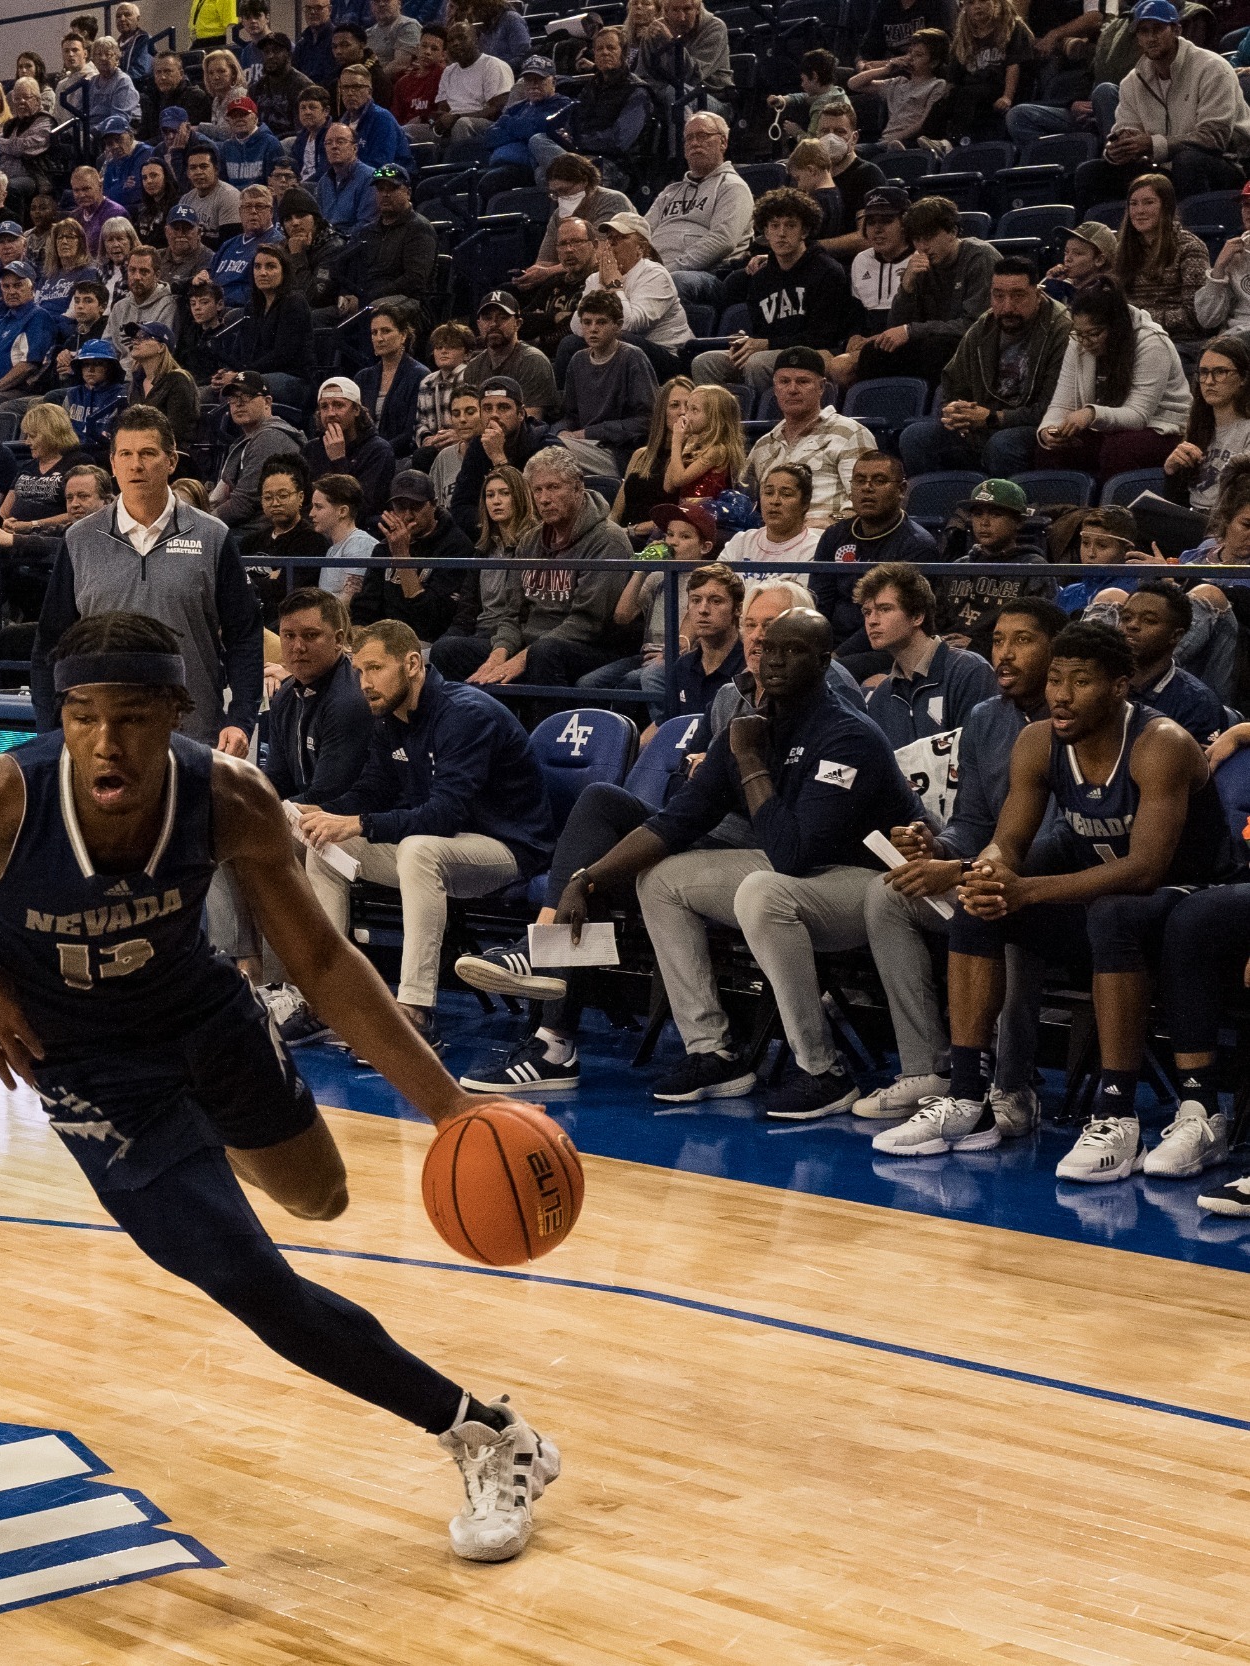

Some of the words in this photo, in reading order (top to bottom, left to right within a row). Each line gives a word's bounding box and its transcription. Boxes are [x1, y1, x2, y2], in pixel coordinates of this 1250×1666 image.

[176, 205, 189, 217] AF
[491, 291, 502, 302] N
[166, 538, 203, 549] NEVADA
[958, 602, 982, 626] AF
[556, 713, 594, 757] AF
[26, 888, 184, 937] NEVADA
[526, 1149, 564, 1236] ELITE
